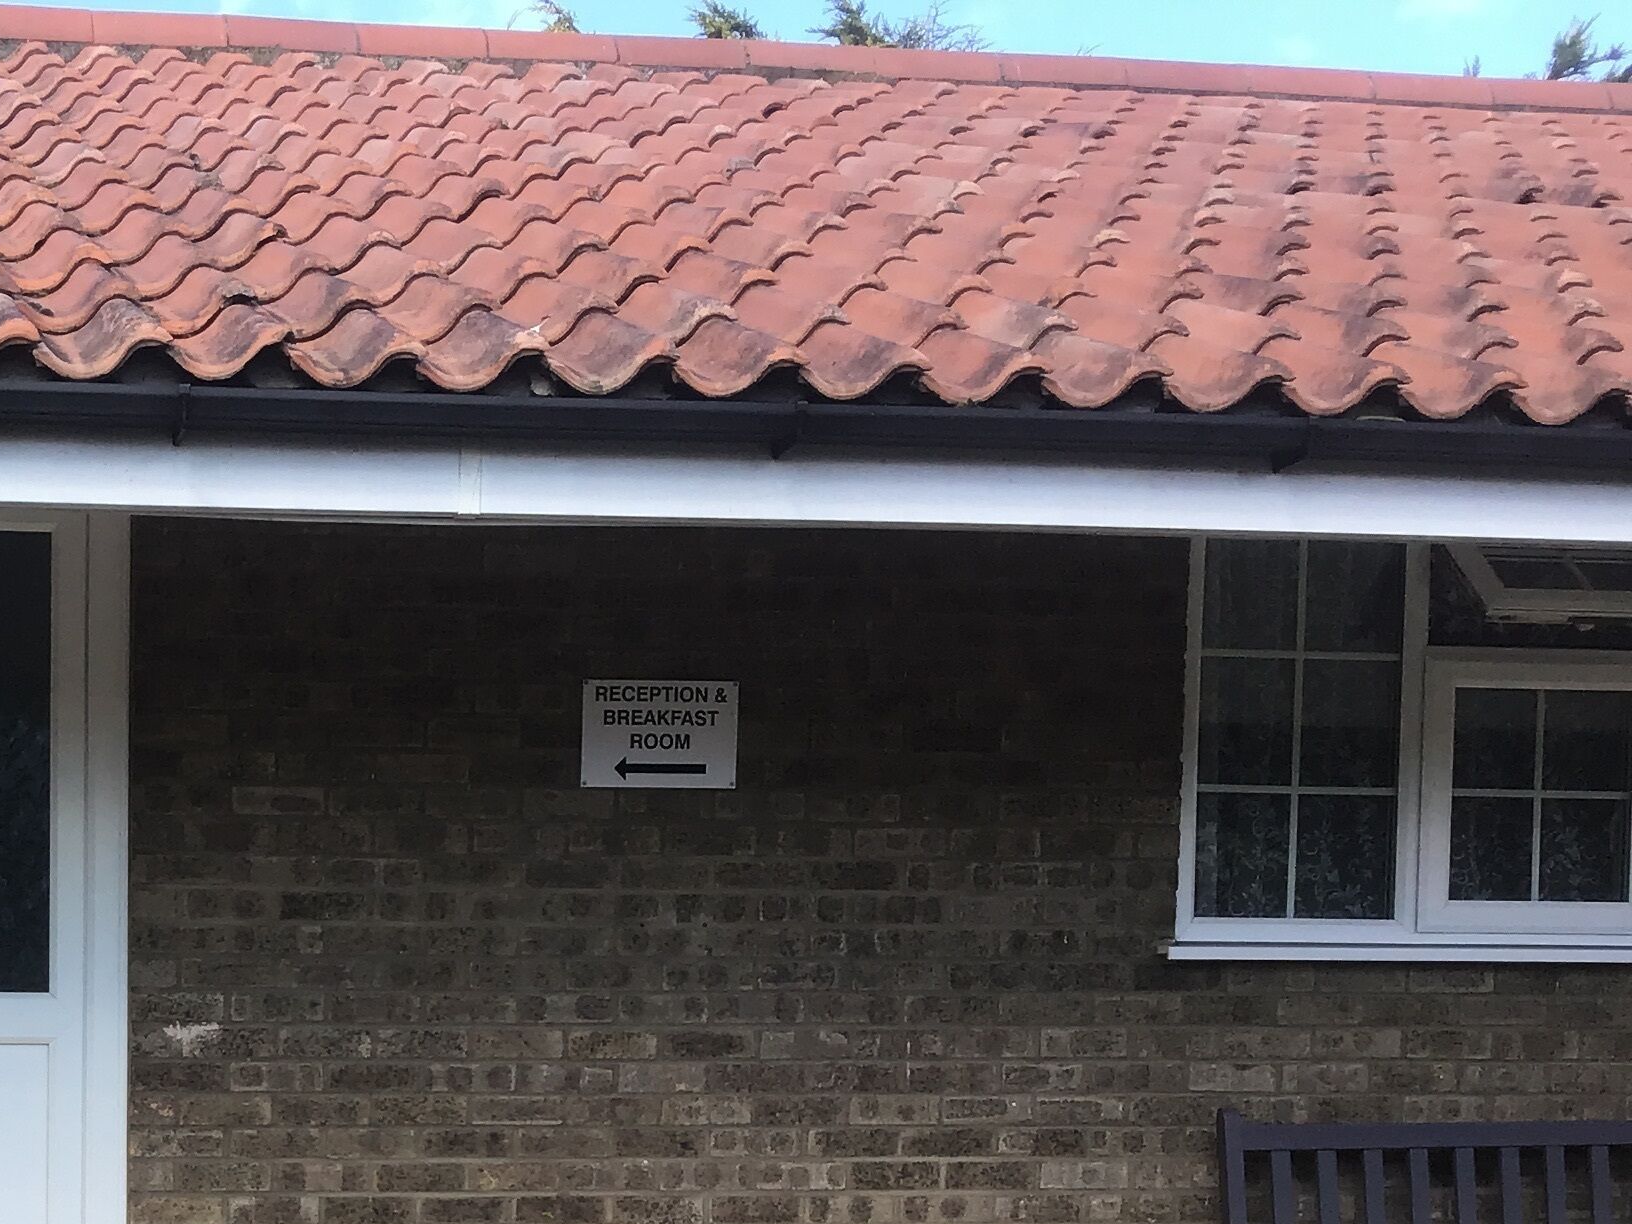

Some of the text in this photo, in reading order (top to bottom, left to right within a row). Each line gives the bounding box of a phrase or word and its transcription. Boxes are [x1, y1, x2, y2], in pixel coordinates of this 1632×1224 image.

[595, 686, 728, 703] RECEPTION &
[603, 709, 719, 726] BREAKFAST
[629, 733, 691, 750] ROOM
